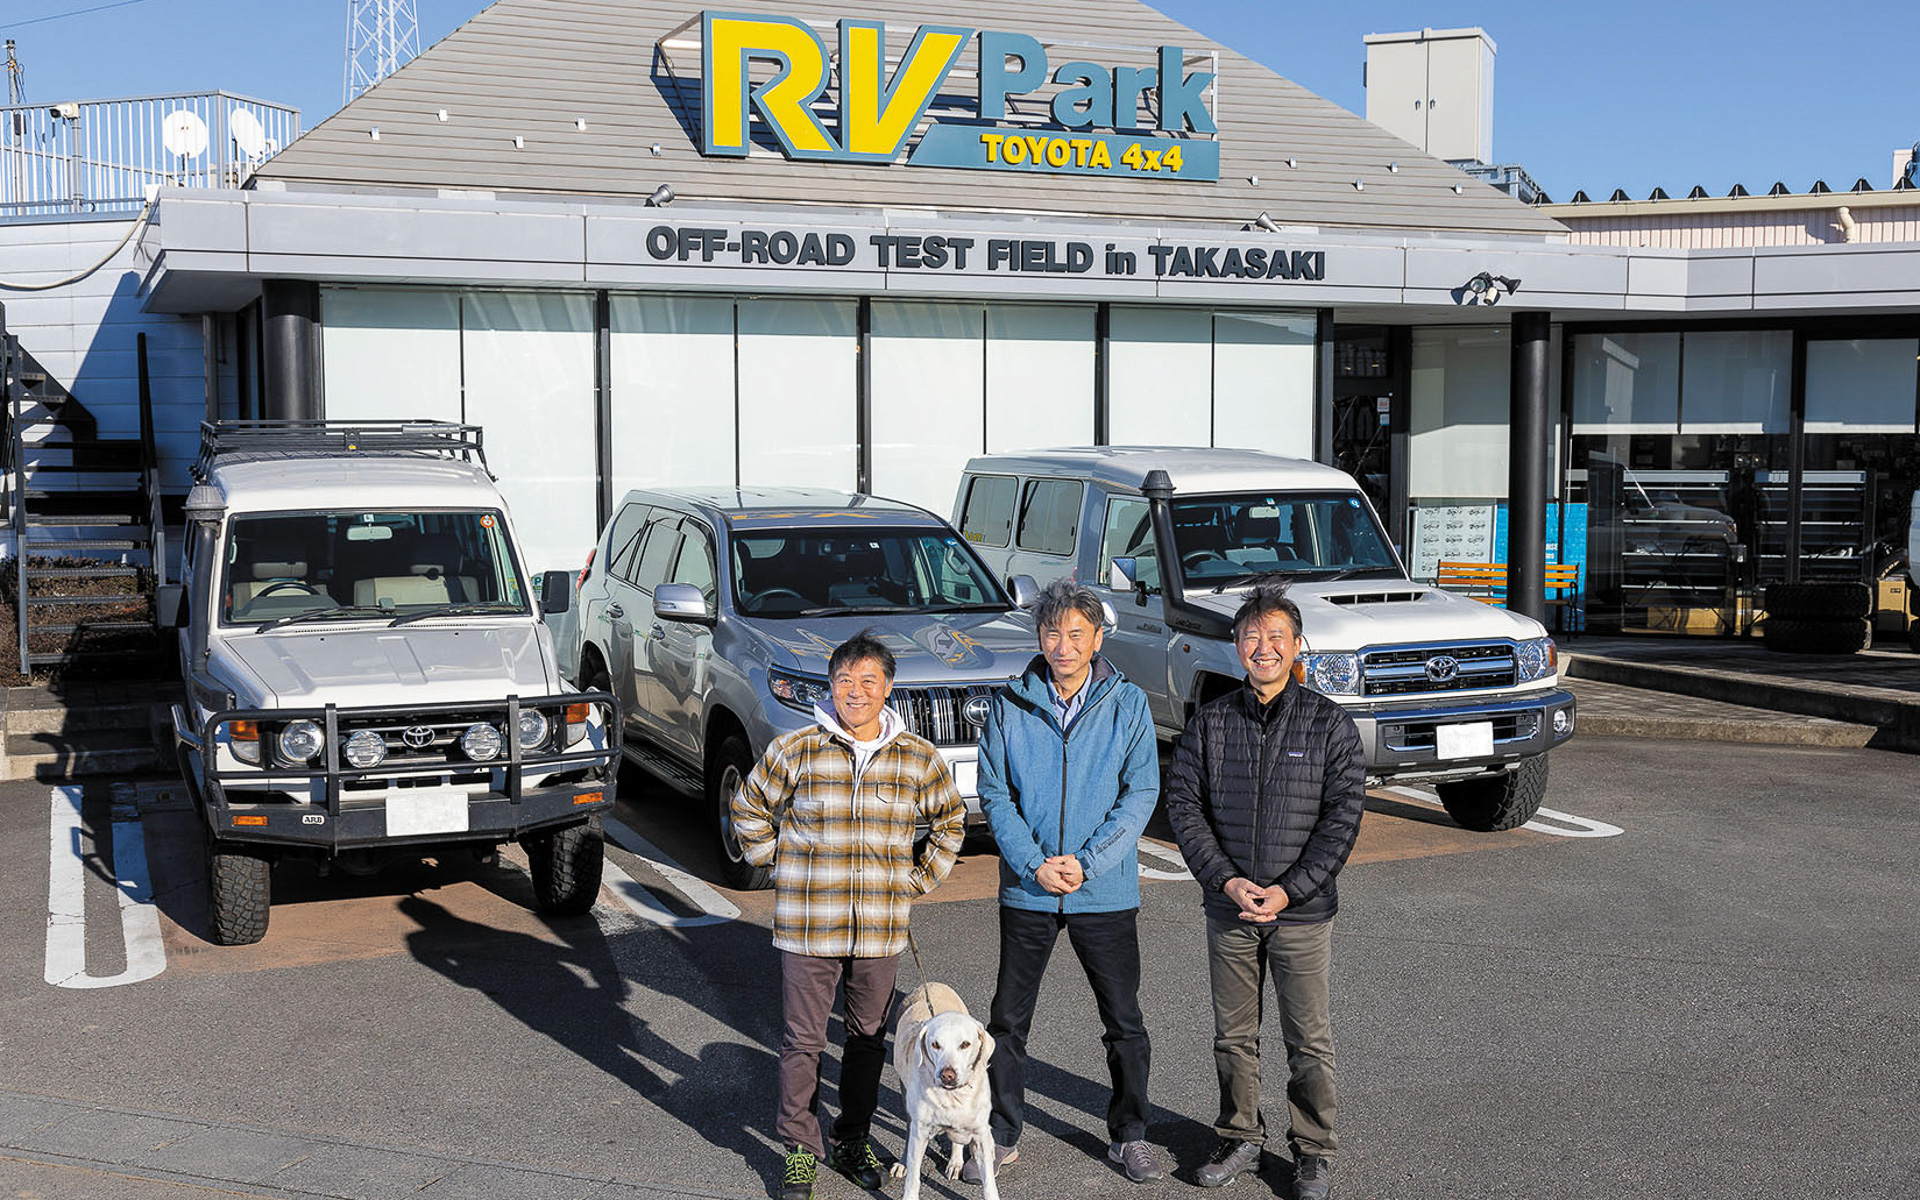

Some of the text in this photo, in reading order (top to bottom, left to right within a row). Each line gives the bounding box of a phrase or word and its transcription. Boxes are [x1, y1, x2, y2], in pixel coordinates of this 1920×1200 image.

[701, 11, 1218, 163] RV Park
[980, 133, 1184, 173] TOYOTA 4x4
[645, 225, 1326, 280] OFF-ROAD TEST FIELD in TAKASAKI
[304, 816, 323, 824] ARB
